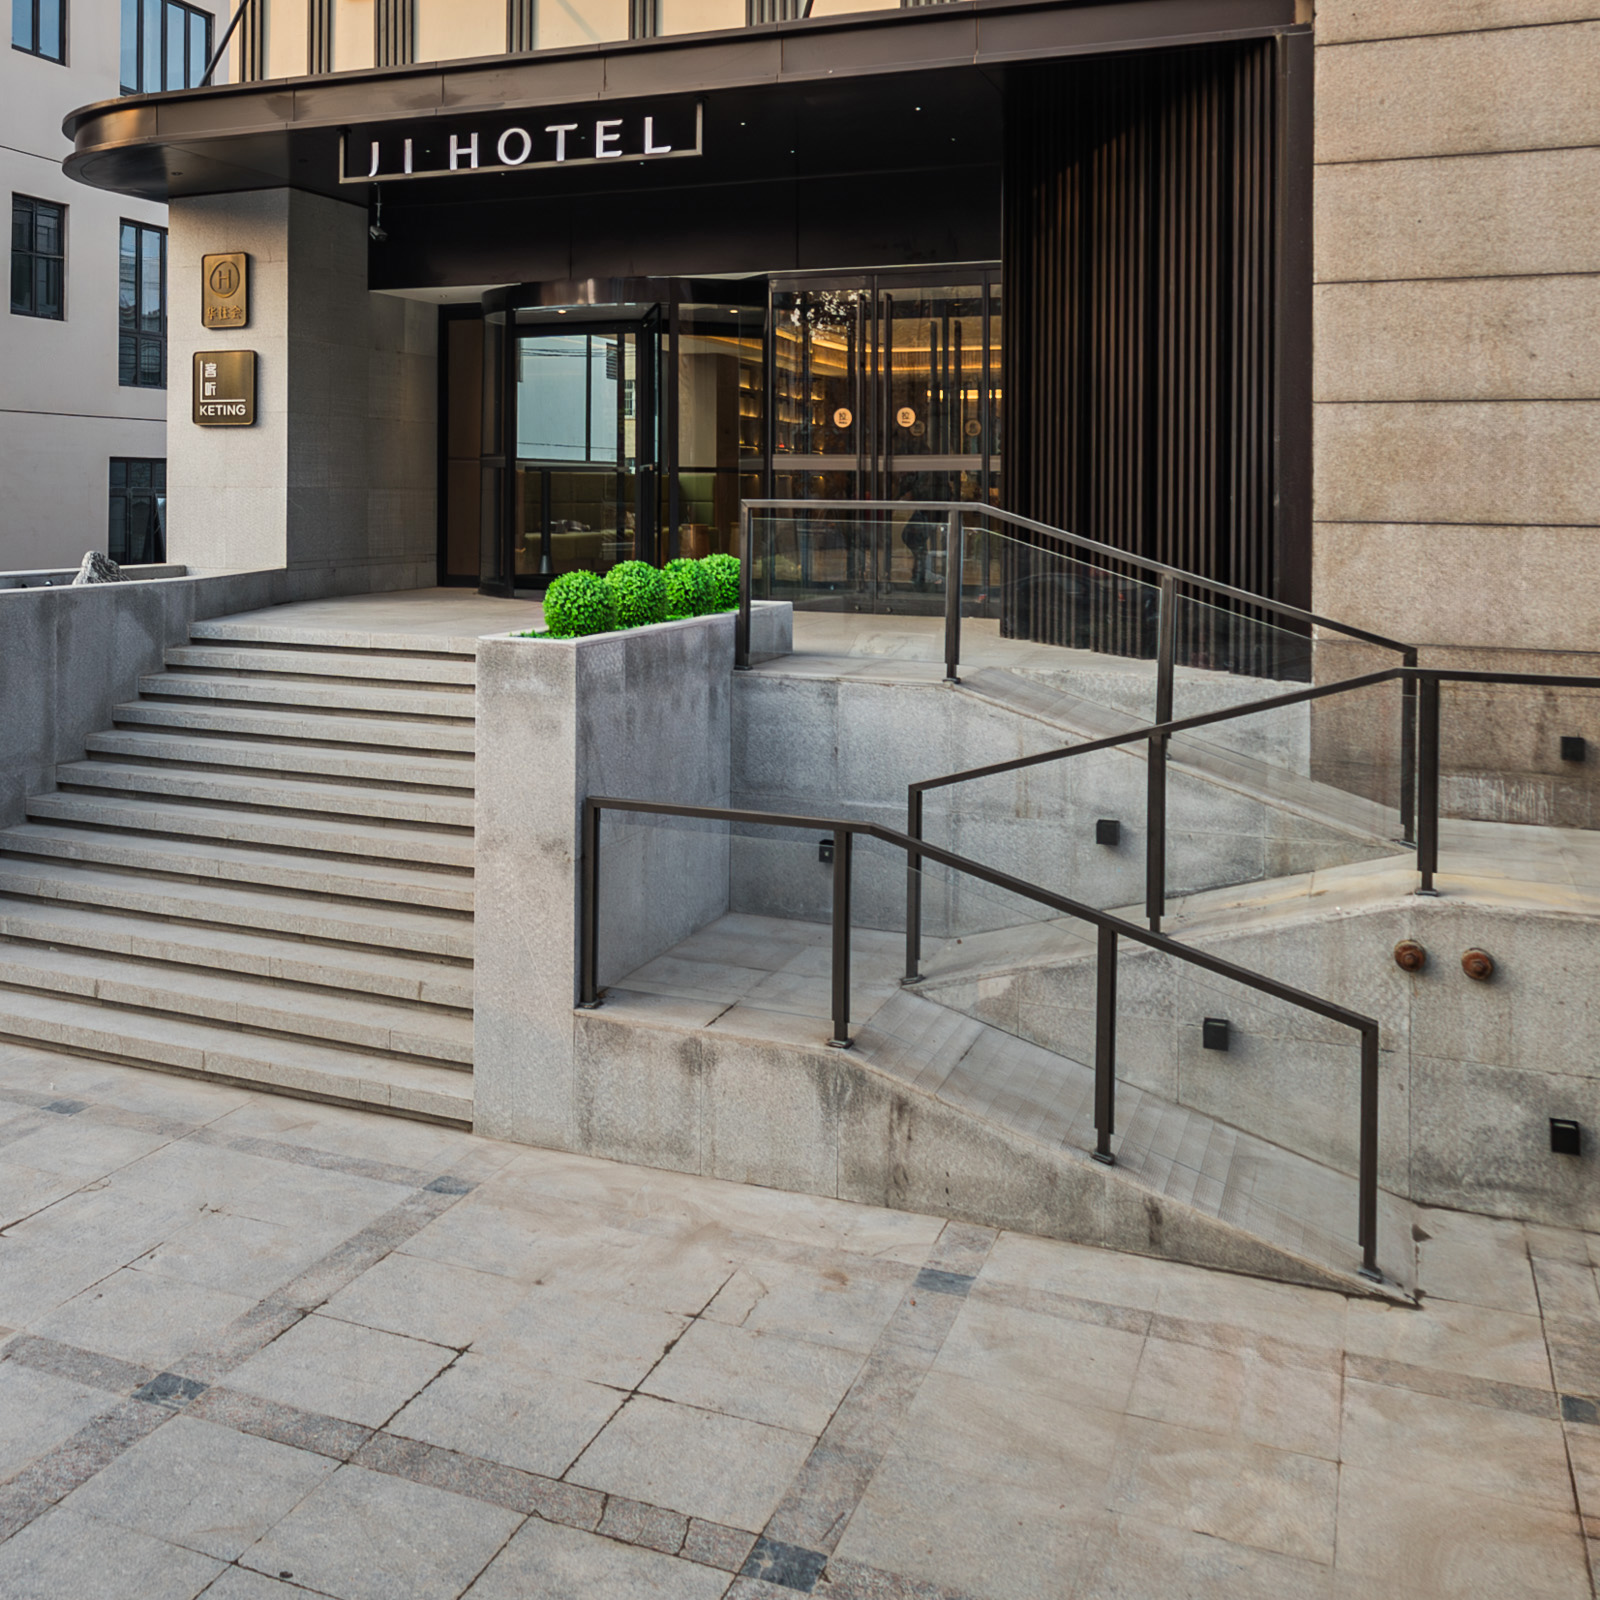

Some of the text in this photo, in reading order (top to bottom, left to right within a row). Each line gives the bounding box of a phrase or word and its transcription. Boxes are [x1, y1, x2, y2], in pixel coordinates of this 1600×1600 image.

[368, 116, 672, 177] JI HOTEL
[200, 404, 246, 416] KETING
